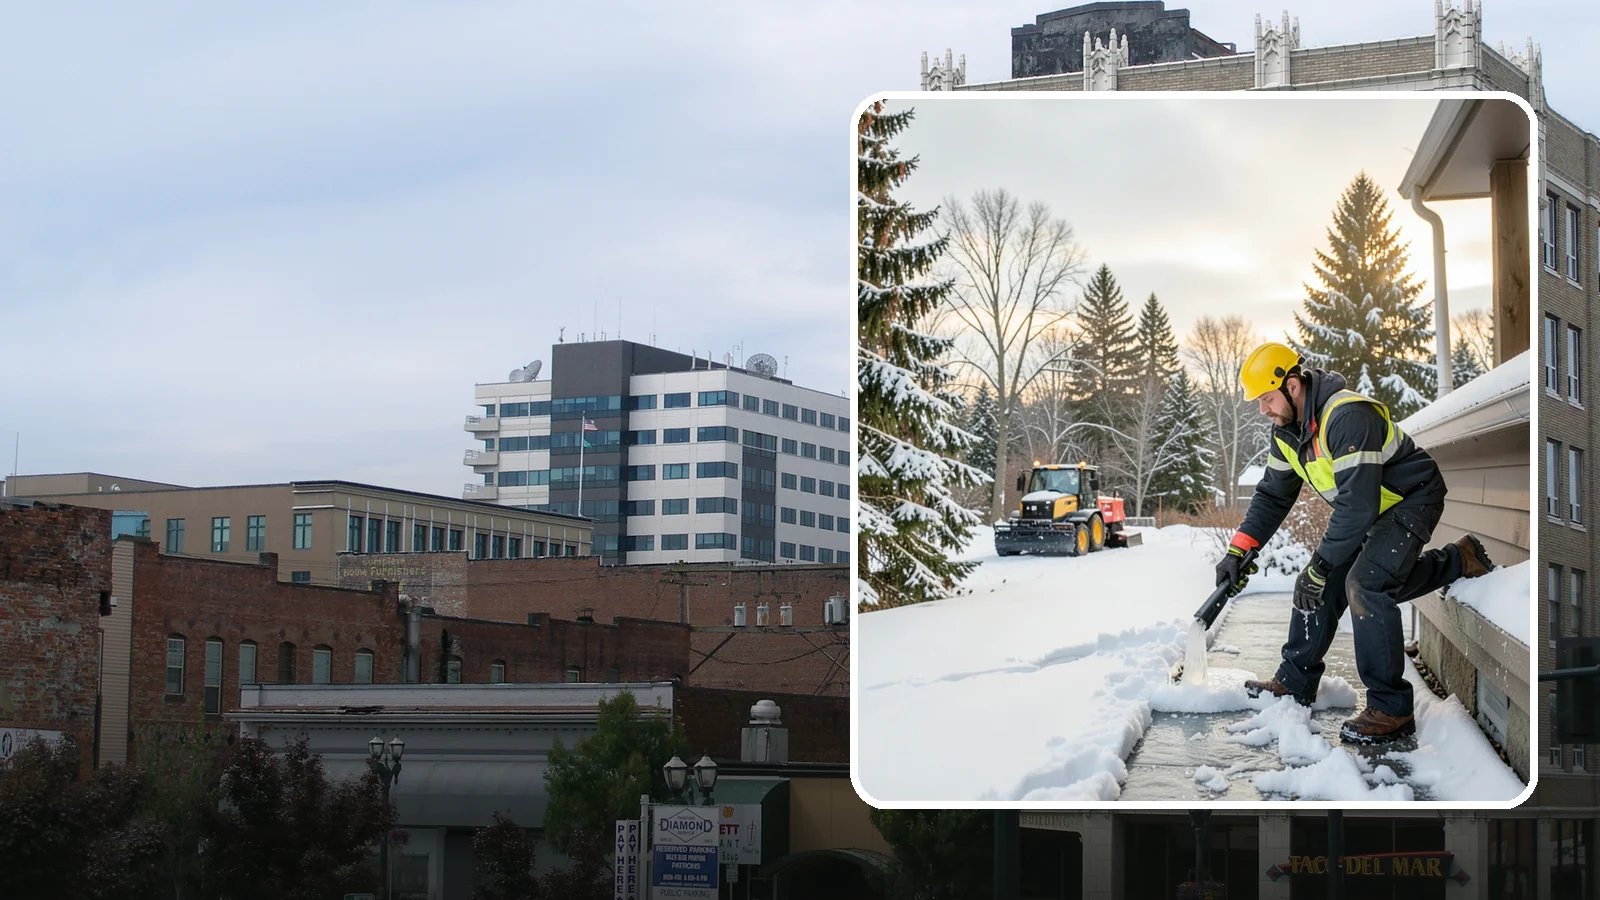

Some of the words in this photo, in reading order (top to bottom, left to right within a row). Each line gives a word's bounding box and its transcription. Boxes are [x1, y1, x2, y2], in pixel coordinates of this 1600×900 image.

[343, 568, 368, 577] Home
[370, 566, 427, 577] Furnishers
[660, 818, 713, 833] DIAMOND
[1021, 815, 1070, 828] BUILDING
[617, 825, 625, 852] PAY
[628, 824, 637, 852] PAY
[655, 845, 688, 853] RESERVED
[689, 846, 716, 854] PARKING
[721, 851, 739, 862] Soup
[671, 862, 701, 870] PATRONS
[1290, 855, 1331, 874] TAC
[1345, 856, 1385, 875] DEL
[1392, 857, 1442, 877] MAR
[617, 856, 625, 893] HERE
[628, 856, 636, 893] HERE
[660, 888, 682, 897] PUBLIC
[683, 889, 710, 898] PARKING
